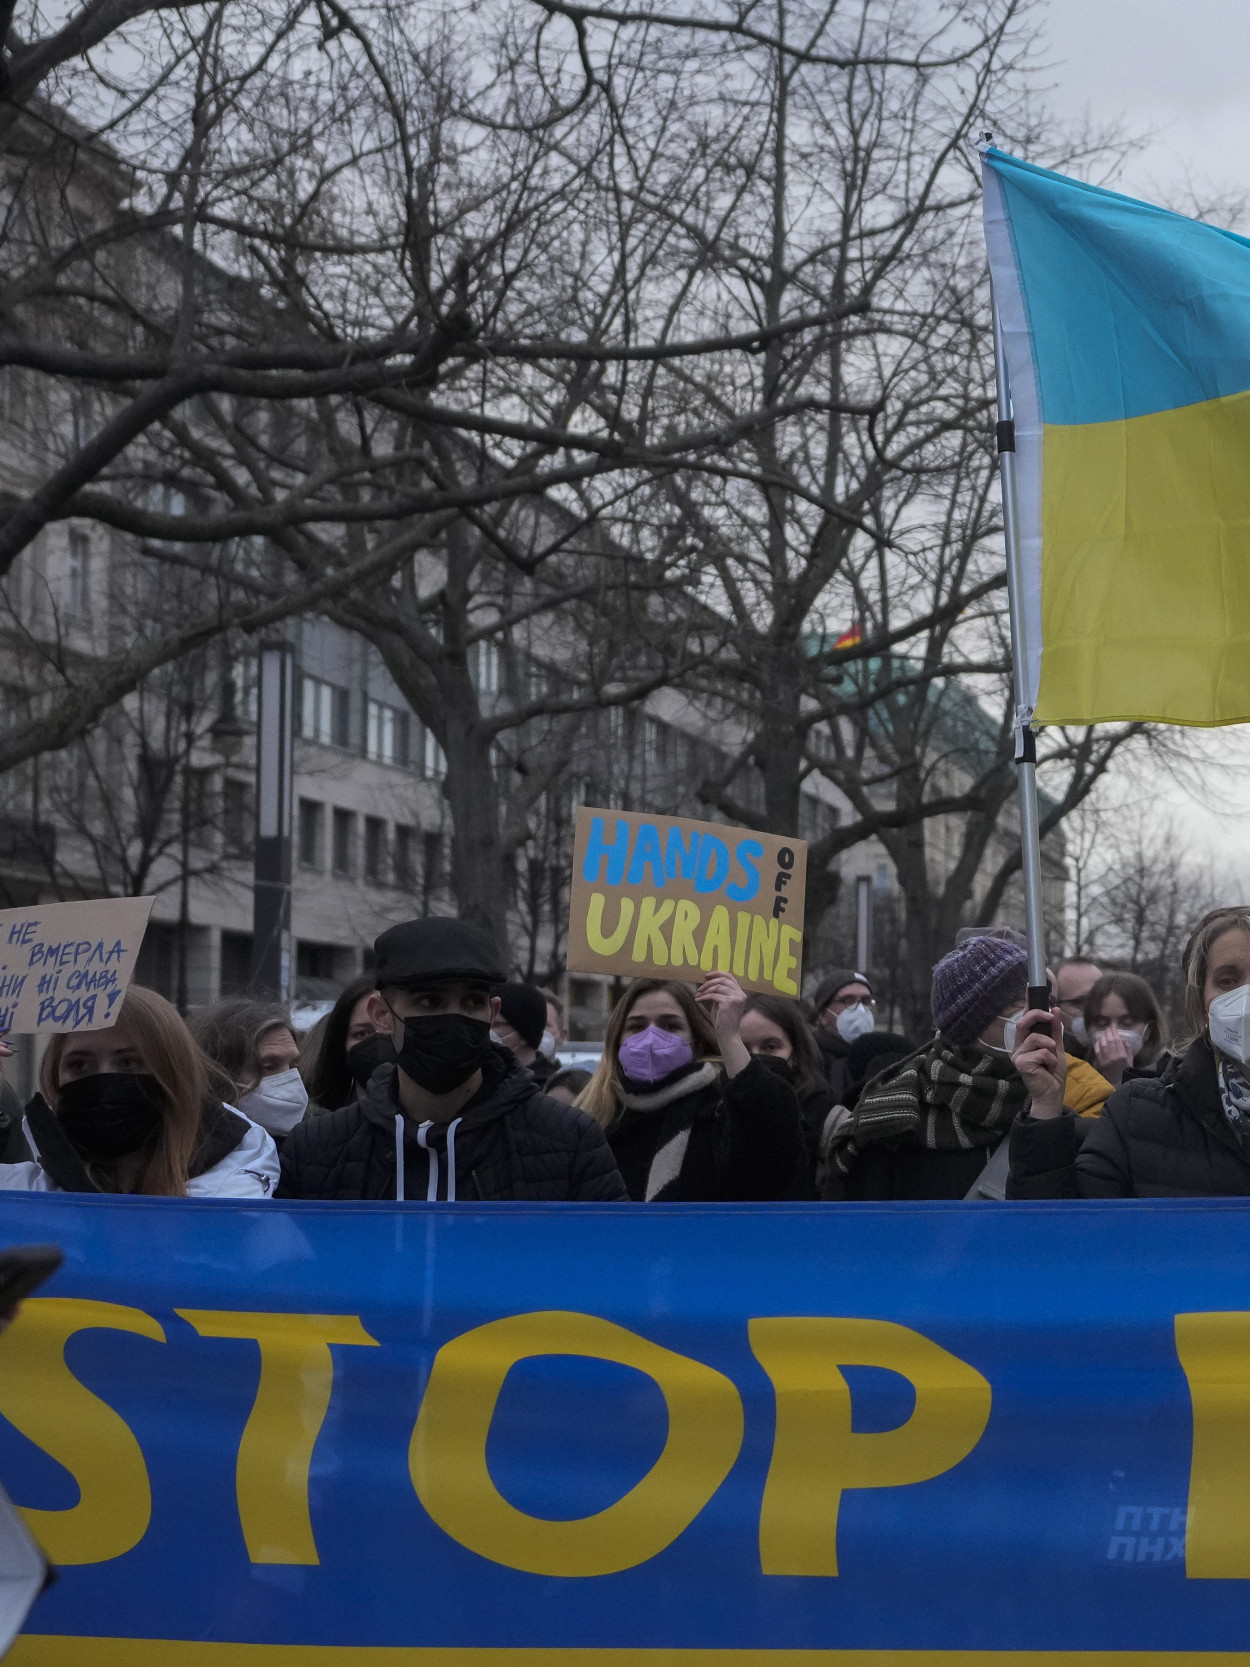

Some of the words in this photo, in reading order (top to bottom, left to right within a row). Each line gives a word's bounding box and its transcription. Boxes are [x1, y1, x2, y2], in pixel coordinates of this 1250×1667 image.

[583, 816, 764, 902] HANDS
[772, 847, 794, 918] OFF
[8, 921, 41, 945] НЕ
[27, 938, 128, 969] ВМЕРЛА
[586, 893, 801, 995] UKRAINE
[0, 965, 28, 998] НИ
[0, 1297, 992, 1578] STOP
